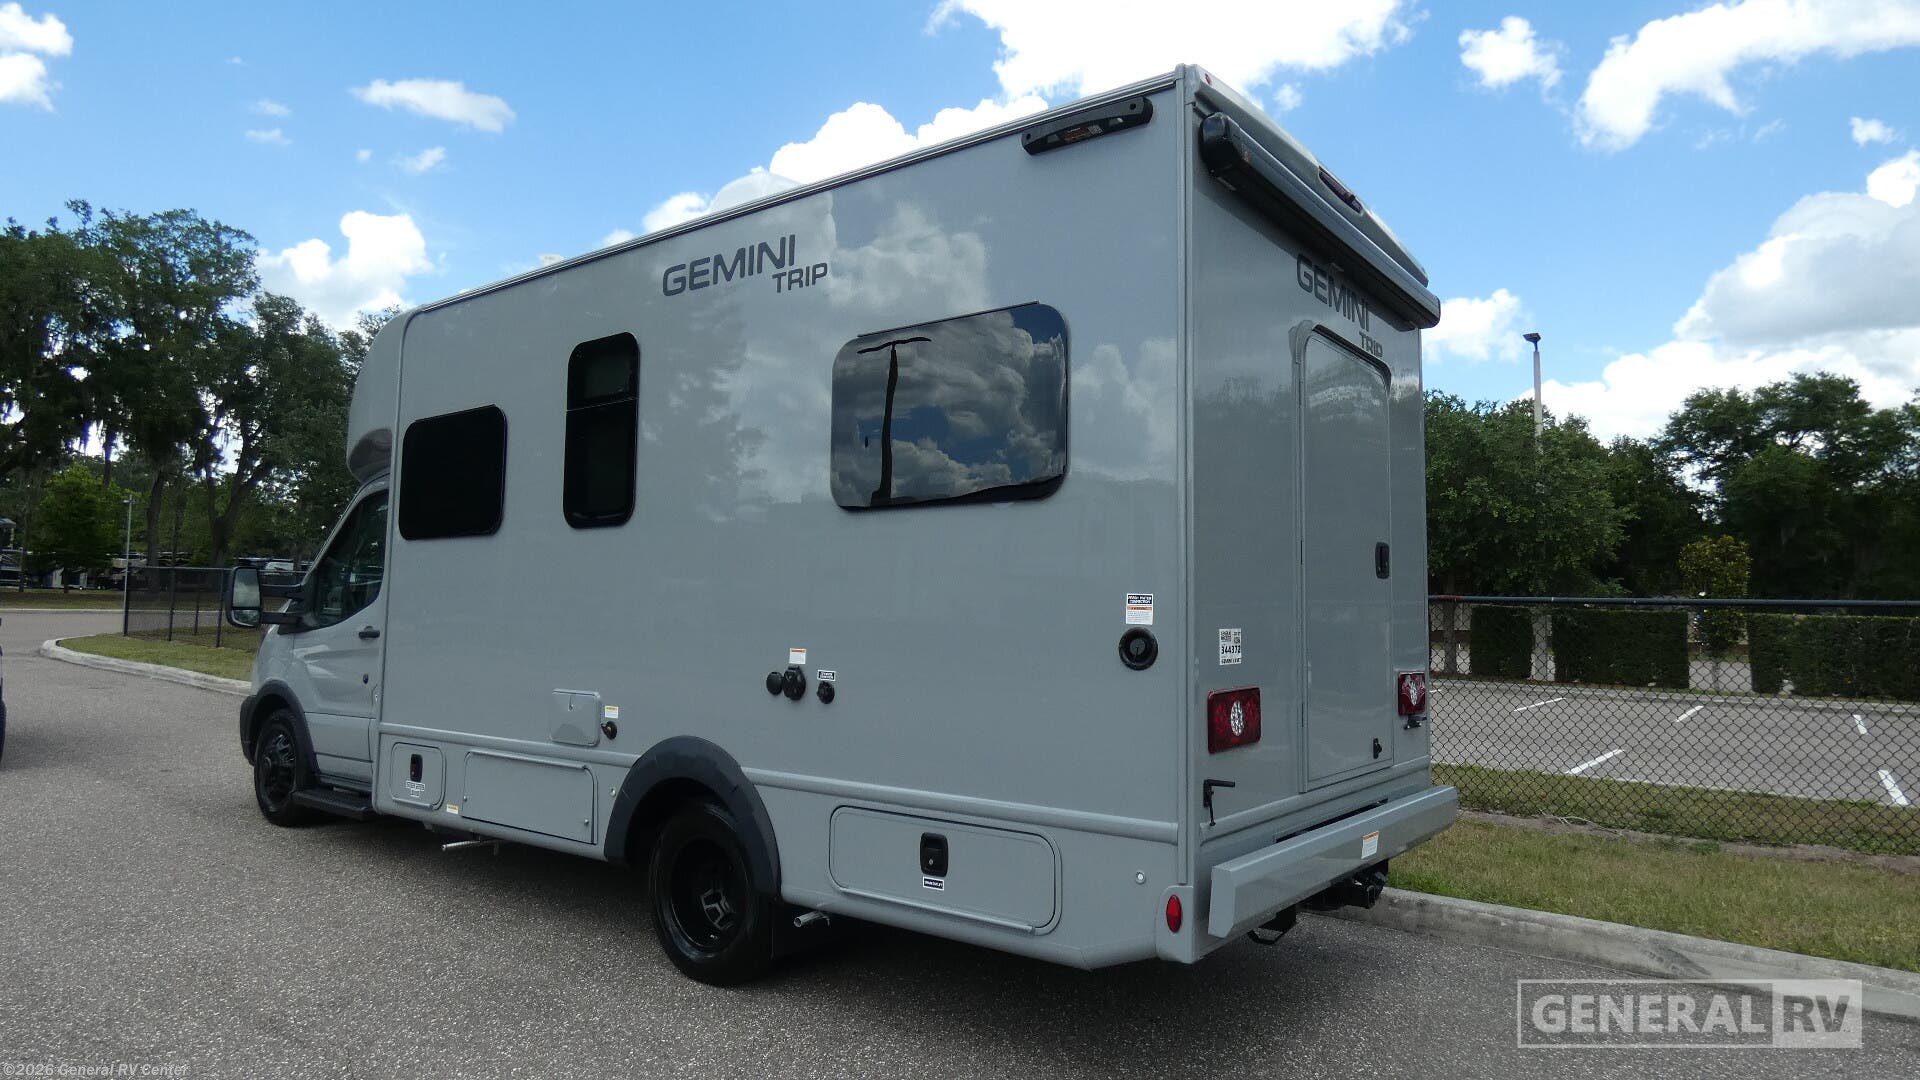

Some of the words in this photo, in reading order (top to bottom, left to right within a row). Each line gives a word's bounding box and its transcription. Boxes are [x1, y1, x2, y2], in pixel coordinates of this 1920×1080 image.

[662, 234, 796, 297] GEMINI
[771, 262, 828, 293] TRIP
[1296, 253, 1370, 332] GEMINI
[1358, 331, 1383, 358] TRIP
